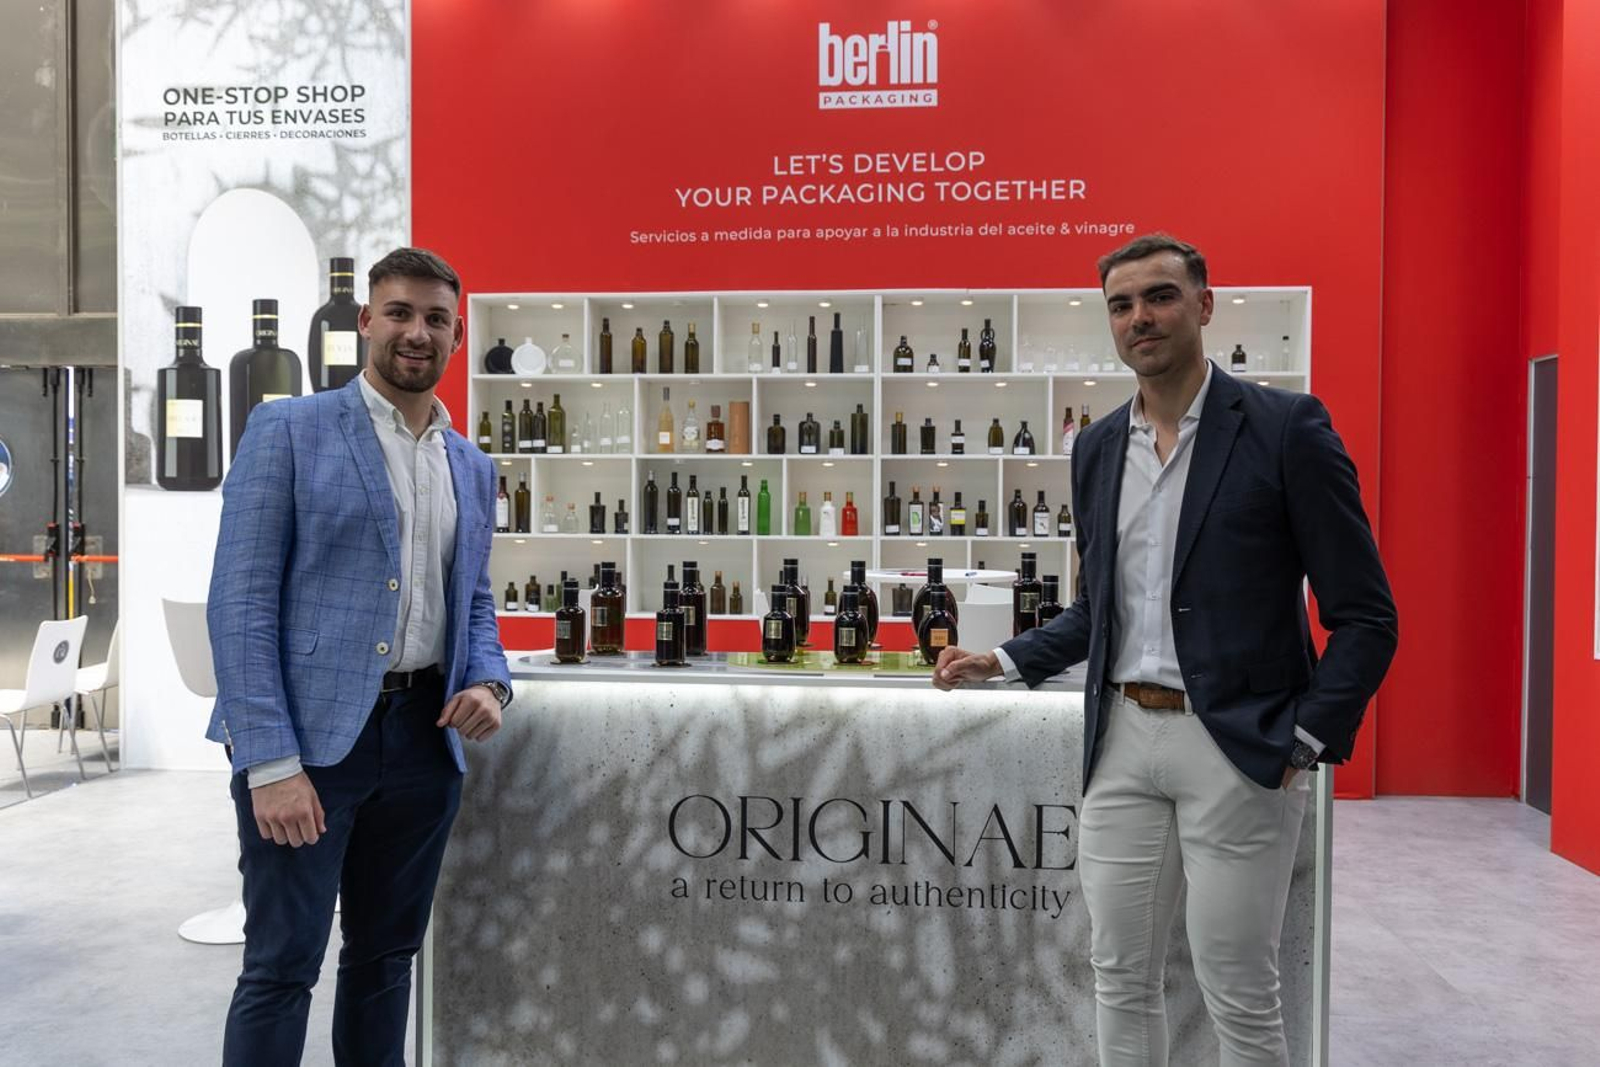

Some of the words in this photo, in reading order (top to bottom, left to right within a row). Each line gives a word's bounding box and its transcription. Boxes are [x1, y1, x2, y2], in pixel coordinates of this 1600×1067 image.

[163, 86, 289, 106] ONE-STOP
[297, 84, 365, 104] SHOP
[823, 93, 933, 105] PACKAGING
[164, 111, 220, 127] PARA
[226, 110, 264, 125] TUS
[271, 108, 365, 125] ENVASES
[163, 132, 216, 140] BOTELLAS
[225, 131, 270, 140] CIERRES
[280, 129, 366, 139] DECORACIONES
[774, 153, 844, 176] LET’S
[854, 151, 985, 174] DEVELOP
[675, 186, 752, 208] YOUR
[762, 182, 925, 205] PACKAGING
[934, 179, 1086, 202] TOGETHER
[630, 231, 697, 243] Servicios
[701, 232, 709, 241] a
[714, 227, 772, 241] medida
[777, 228, 811, 241] para
[815, 228, 868, 241] apoyar
[873, 227, 881, 237] a
[886, 225, 899, 237] la
[904, 224, 973, 237] industria
[978, 223, 1003, 236] del
[1007, 224, 1056, 235] aceite
[1060, 222, 1070, 235] &
[1075, 223, 1135, 237] vinagre
[668, 794, 1077, 871] ORIGINAE
[670, 877, 690, 899] a
[706, 875, 804, 904] return
[823, 878, 853, 904] to
[869, 880, 1071, 920] authenticity
